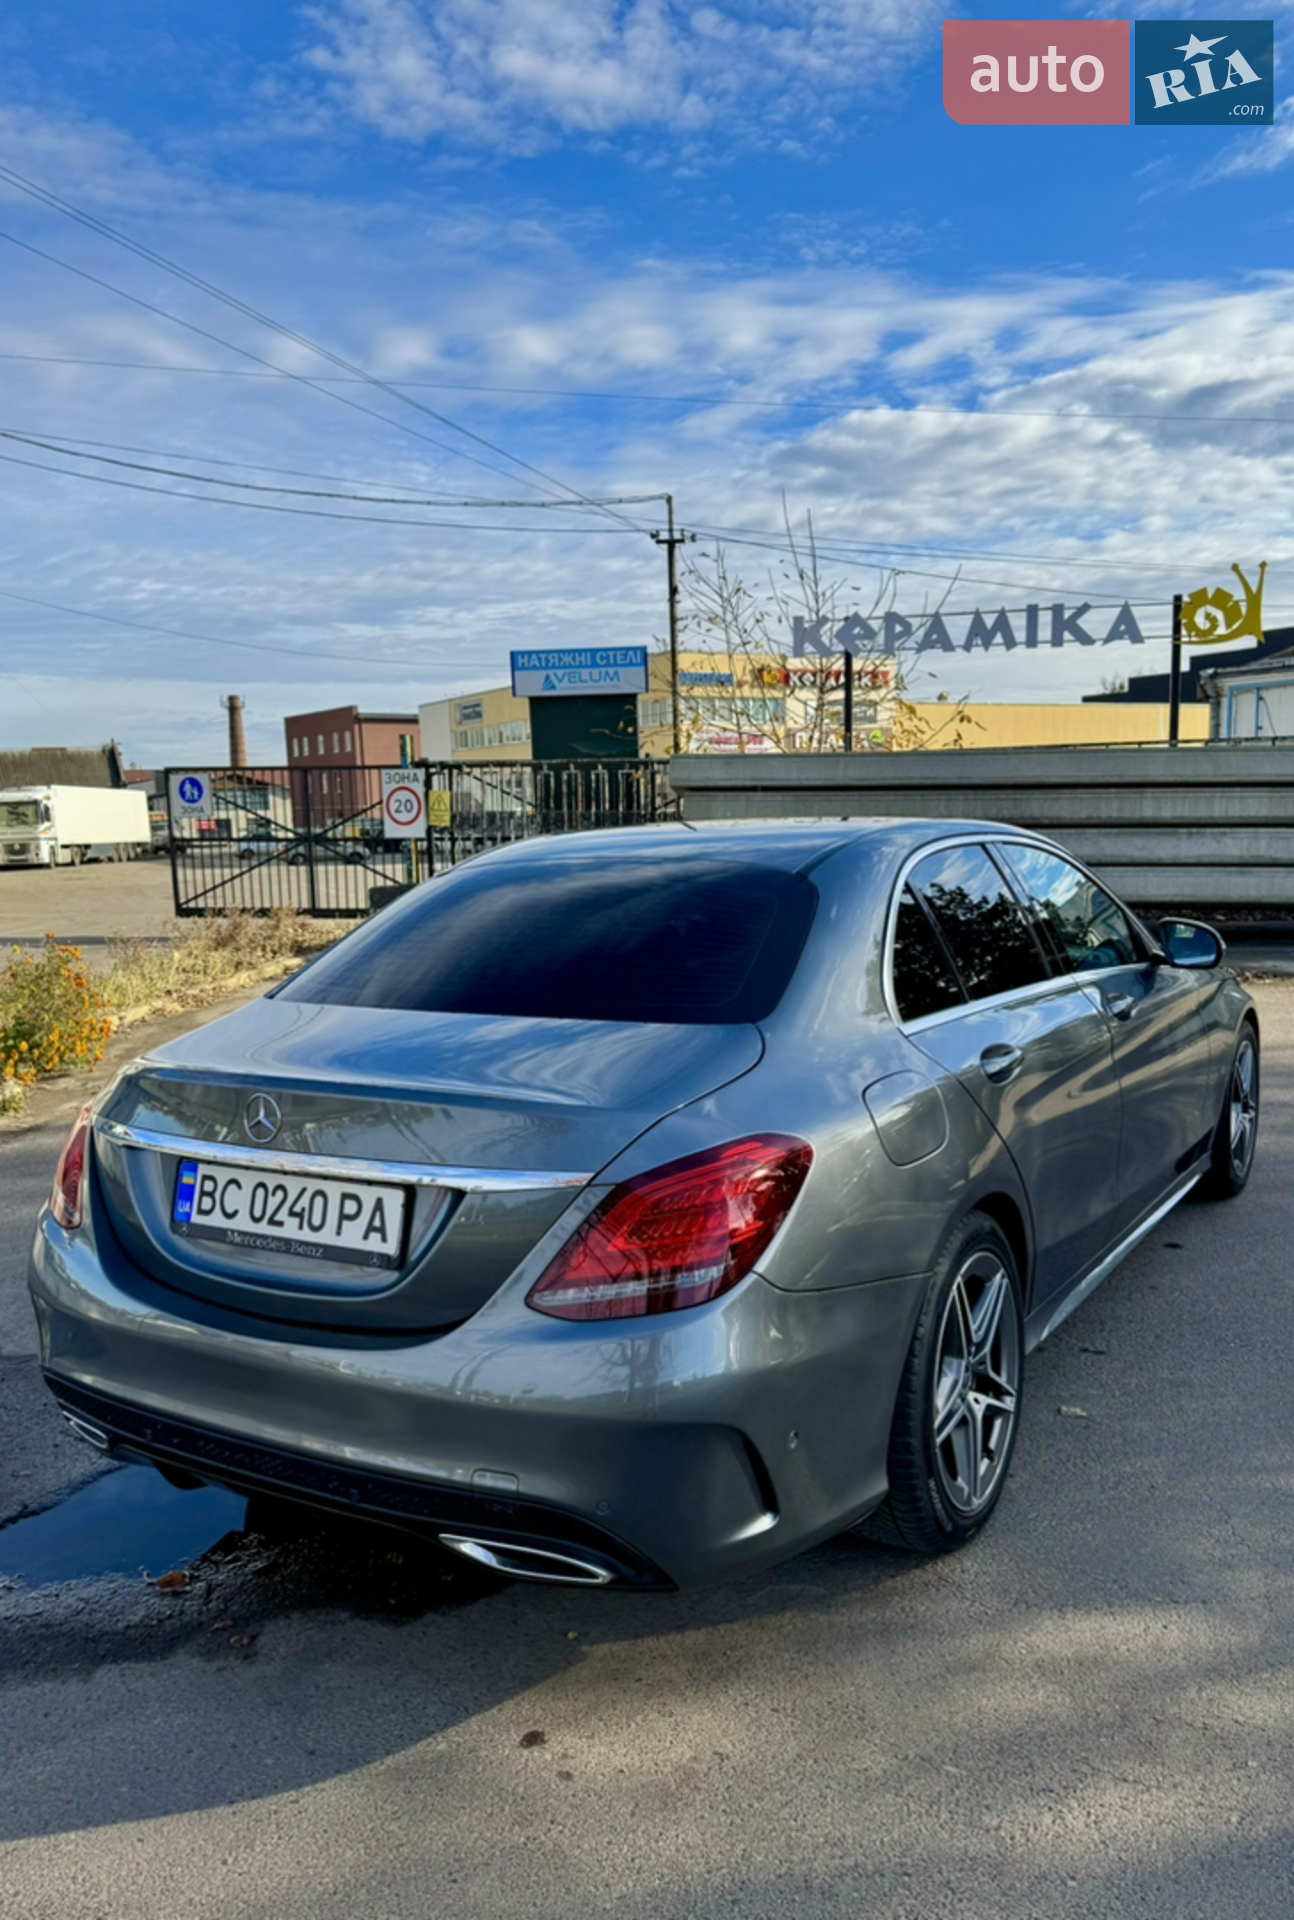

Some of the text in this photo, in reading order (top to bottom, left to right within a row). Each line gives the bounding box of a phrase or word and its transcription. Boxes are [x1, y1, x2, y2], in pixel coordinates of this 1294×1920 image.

[518, 649, 641, 668] НАТЯЖНІ СТЕЛІ
[553, 669, 621, 684] VELUM
[384, 772, 420, 785] ЗОНА
[394, 799, 414, 814] 20
[196, 1174, 388, 1244] BC 0240 PA
[226, 1230, 325, 1257] Mercedes-Benz
